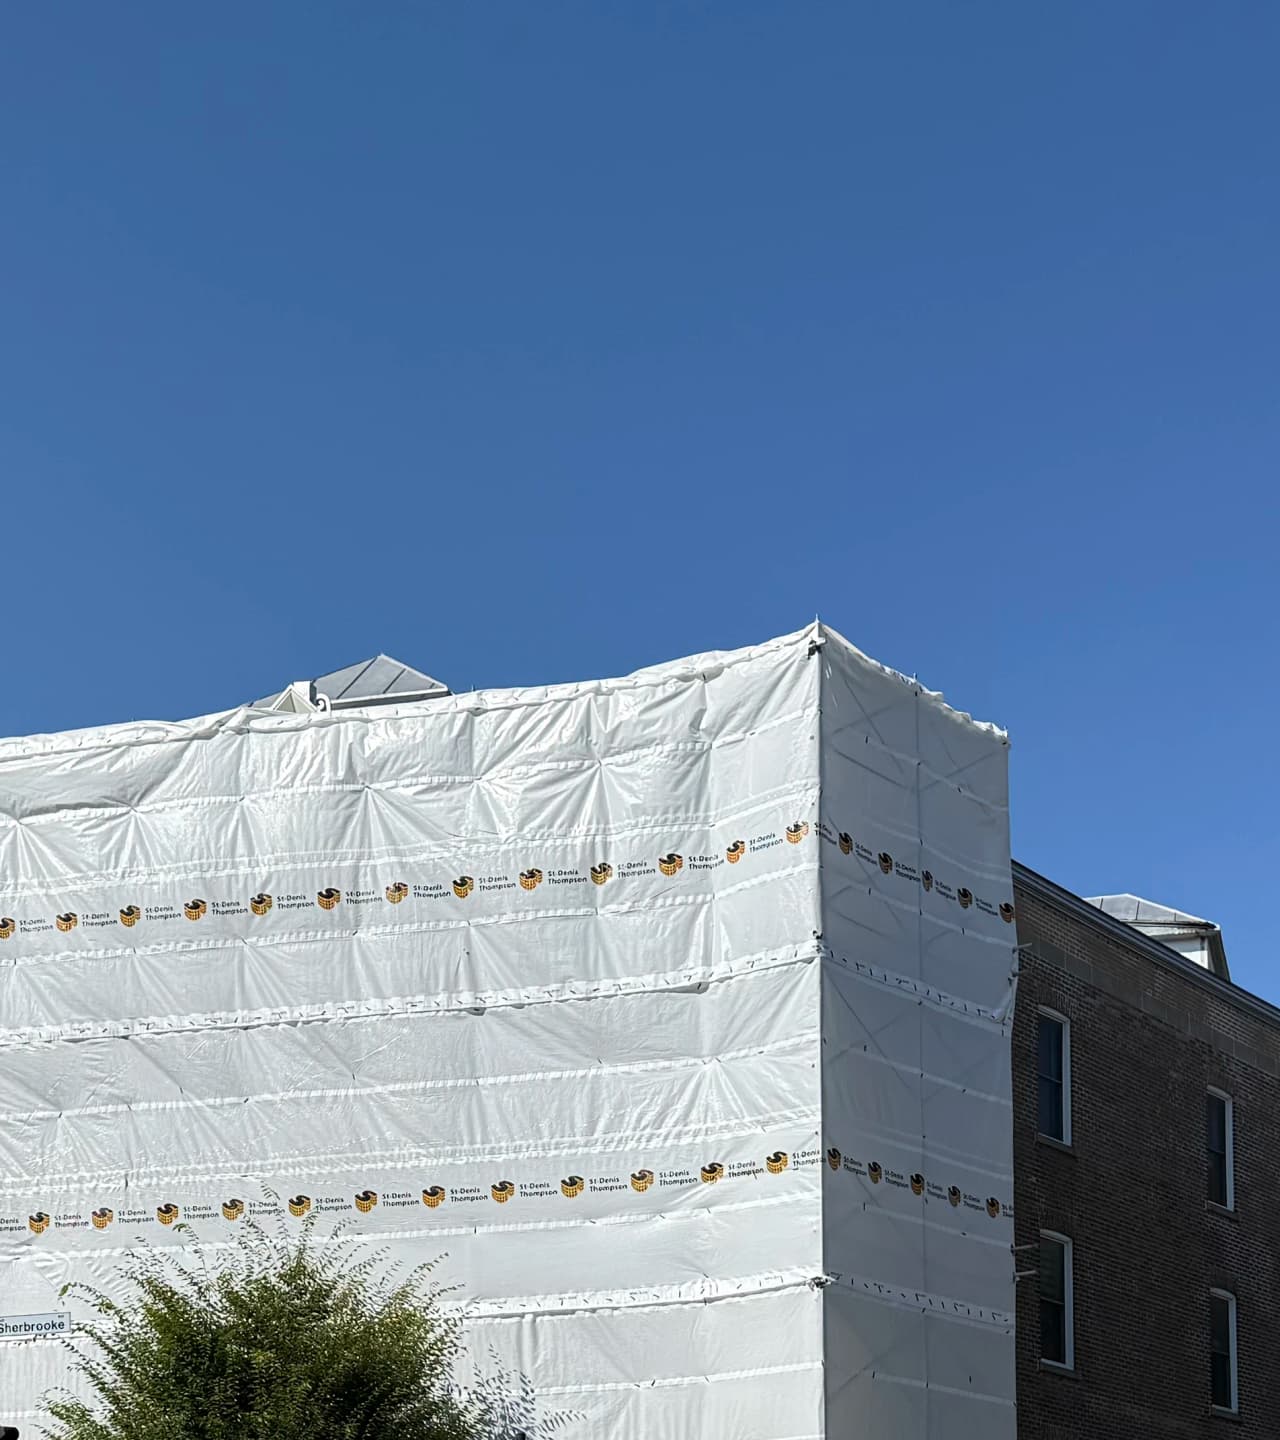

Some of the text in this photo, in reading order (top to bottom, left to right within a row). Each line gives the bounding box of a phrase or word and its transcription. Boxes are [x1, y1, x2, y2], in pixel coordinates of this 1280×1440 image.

[548, 876, 587, 885] Thompson
[479, 882, 516, 892] Thompson
[413, 890, 451, 899] Thompson
[277, 901, 315, 910] Thompson
[211, 907, 248, 917] Thompson
[728, 1160, 756, 1170] St-Denis
[659, 1170, 690, 1178] St-Denis
[728, 1167, 764, 1178] Thompson
[589, 1176, 620, 1185] St-Denis
[659, 1177, 698, 1187] Thompson
[520, 1182, 550, 1190] St-Denis
[589, 1183, 628, 1192] Thompson
[450, 1187, 480, 1195] St-Denis
[520, 1189, 558, 1197] Thompson
[382, 1192, 411, 1200] St-Denis
[450, 1194, 488, 1203] Thompson
[382, 1199, 420, 1207] Thompson
[118, 1216, 155, 1224] Thompson
[183, 1211, 220, 1220] Thompson
[54, 1220, 89, 1229] Thompson
